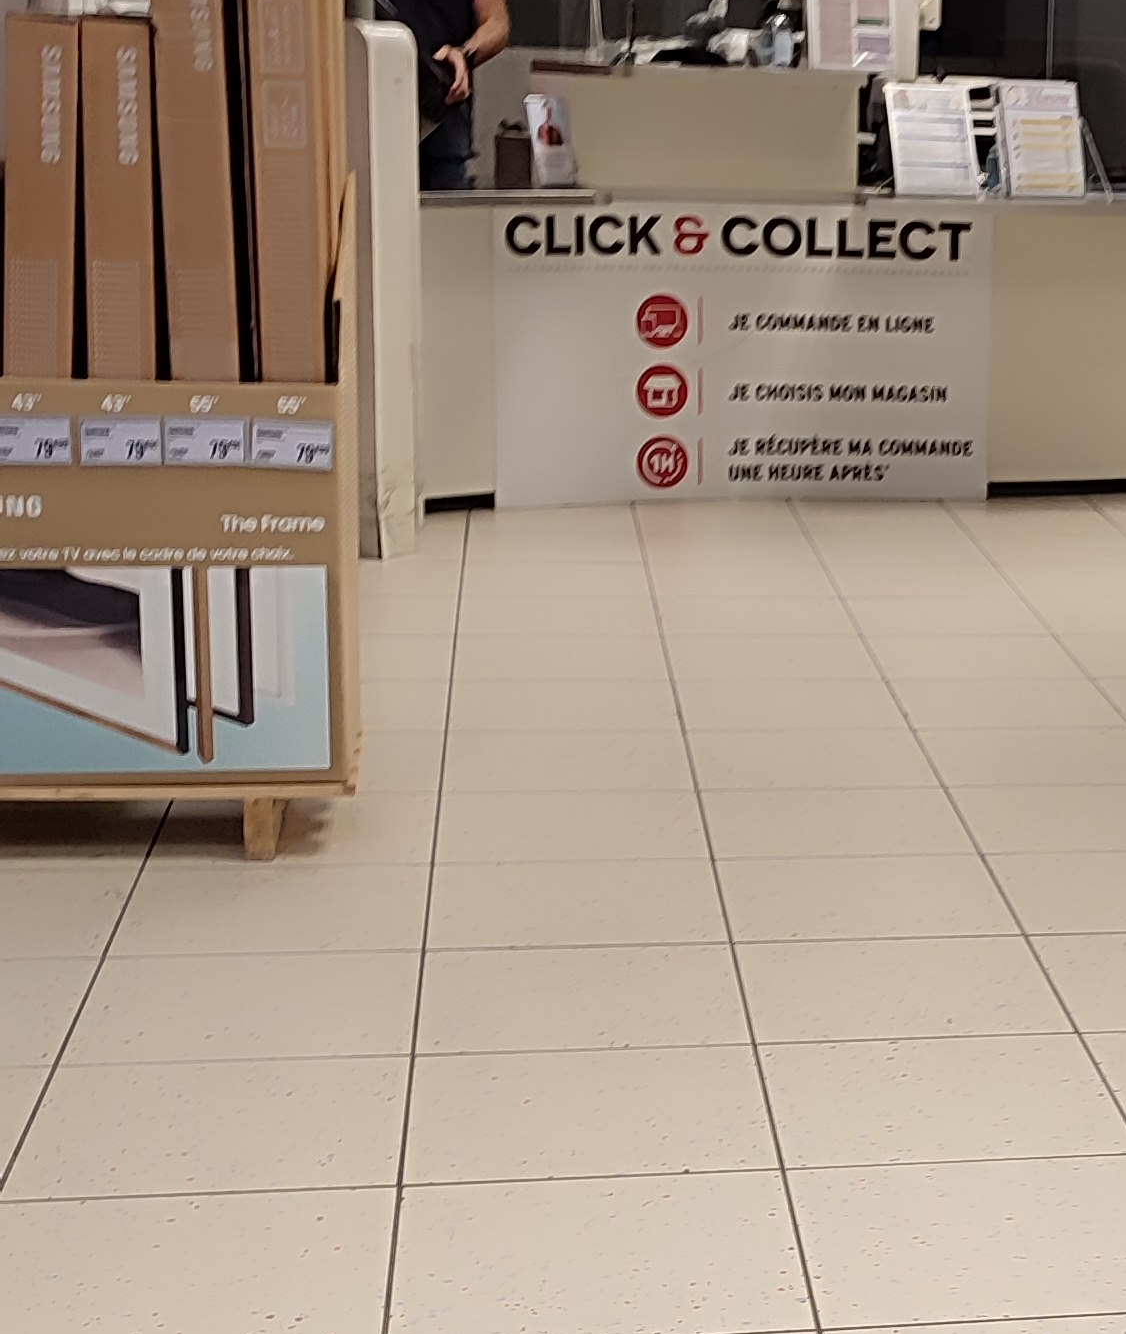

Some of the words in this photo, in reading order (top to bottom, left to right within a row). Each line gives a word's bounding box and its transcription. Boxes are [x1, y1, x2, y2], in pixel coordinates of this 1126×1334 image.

[40, 45, 62, 165] SAMSUNG
[116, 45, 139, 165] SAMSUNG
[504, 214, 662, 257] CLICK
[672, 215, 710, 256] &
[721, 216, 973, 262] COLLECT
[729, 313, 751, 332] JE
[755, 313, 852, 333] COMMANDE
[857, 315, 880, 333] EN
[885, 315, 936, 334] LIGNE
[729, 383, 751, 402] JE
[755, 383, 824, 402] CHOISIS
[828, 384, 867, 403] MON
[871, 384, 949, 403] MAGASIN
[729, 437, 751, 456] JE
[755, 432, 844, 457] RÉCUPÈRE
[848, 438, 873, 456] MA
[878, 439, 975, 458] COMMANDE
[728, 463, 764, 482] UNE
[768, 463, 825, 482] HEURE
[220, 513, 258, 534] The
[261, 513, 326, 534] Frame
[63, 546, 81, 561] TV
